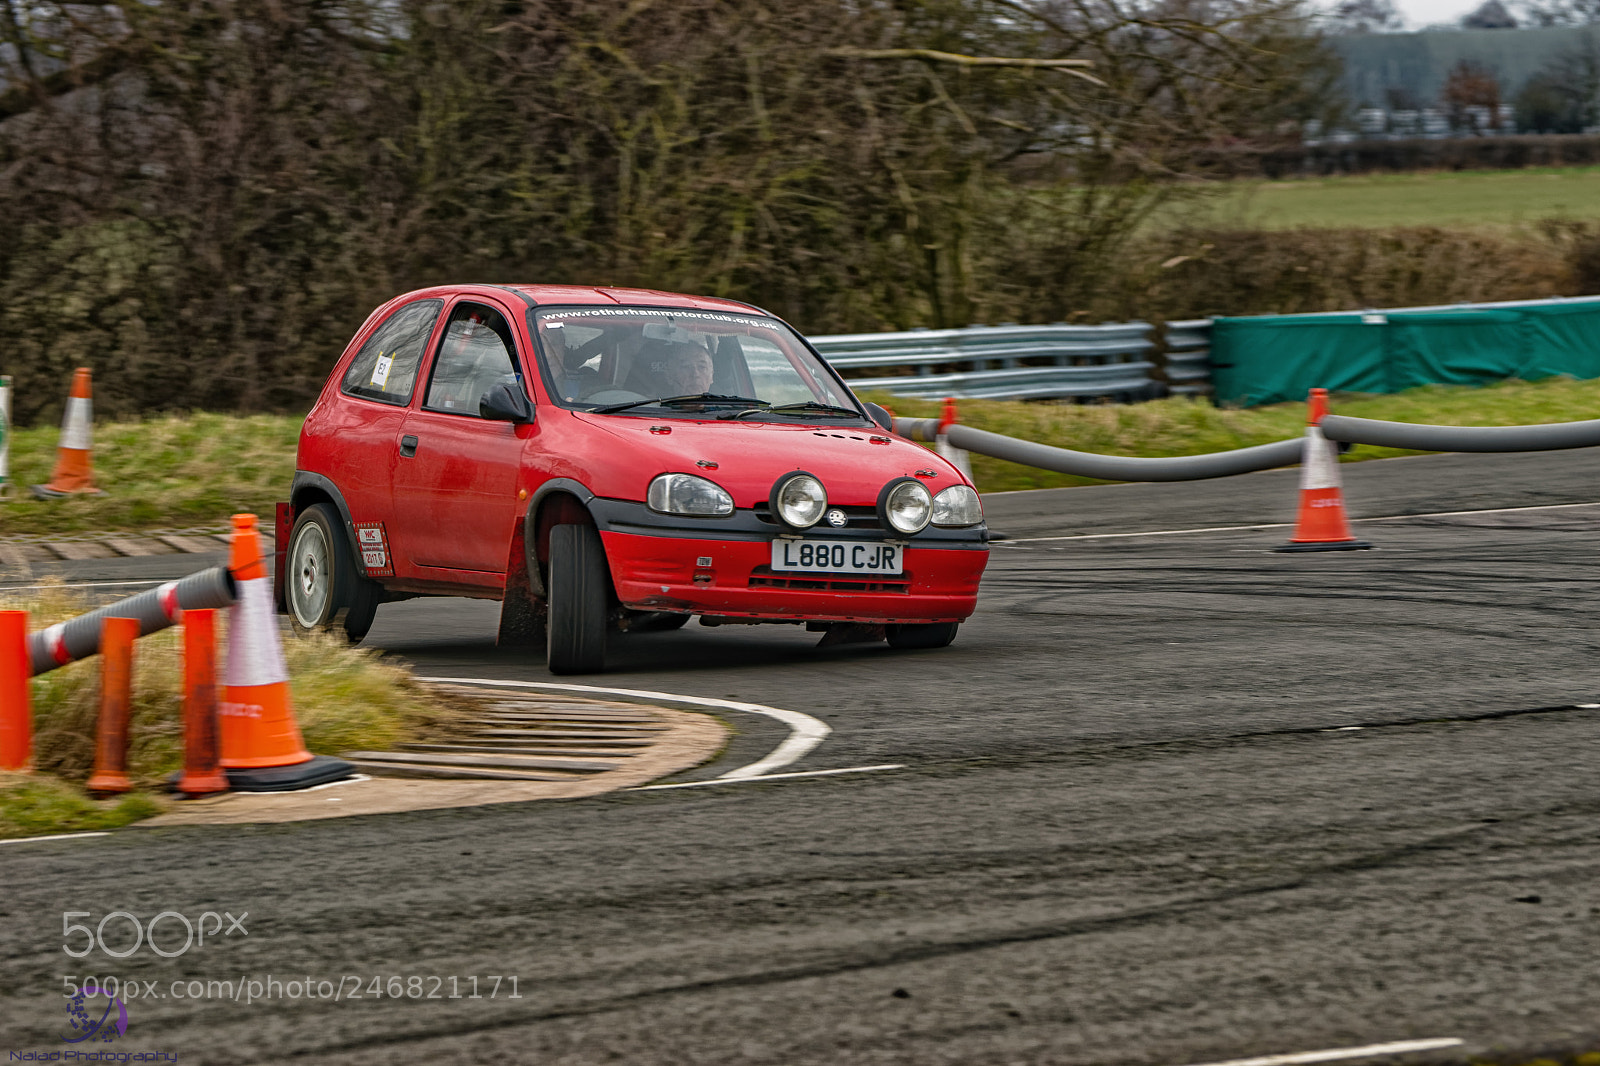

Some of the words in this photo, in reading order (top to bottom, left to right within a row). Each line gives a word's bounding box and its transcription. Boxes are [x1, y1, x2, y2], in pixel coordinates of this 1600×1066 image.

[542, 308, 780, 331] www.rotherhammotorclub.org.uk
[784, 543, 845, 568] L880
[852, 545, 896, 570] CJR
